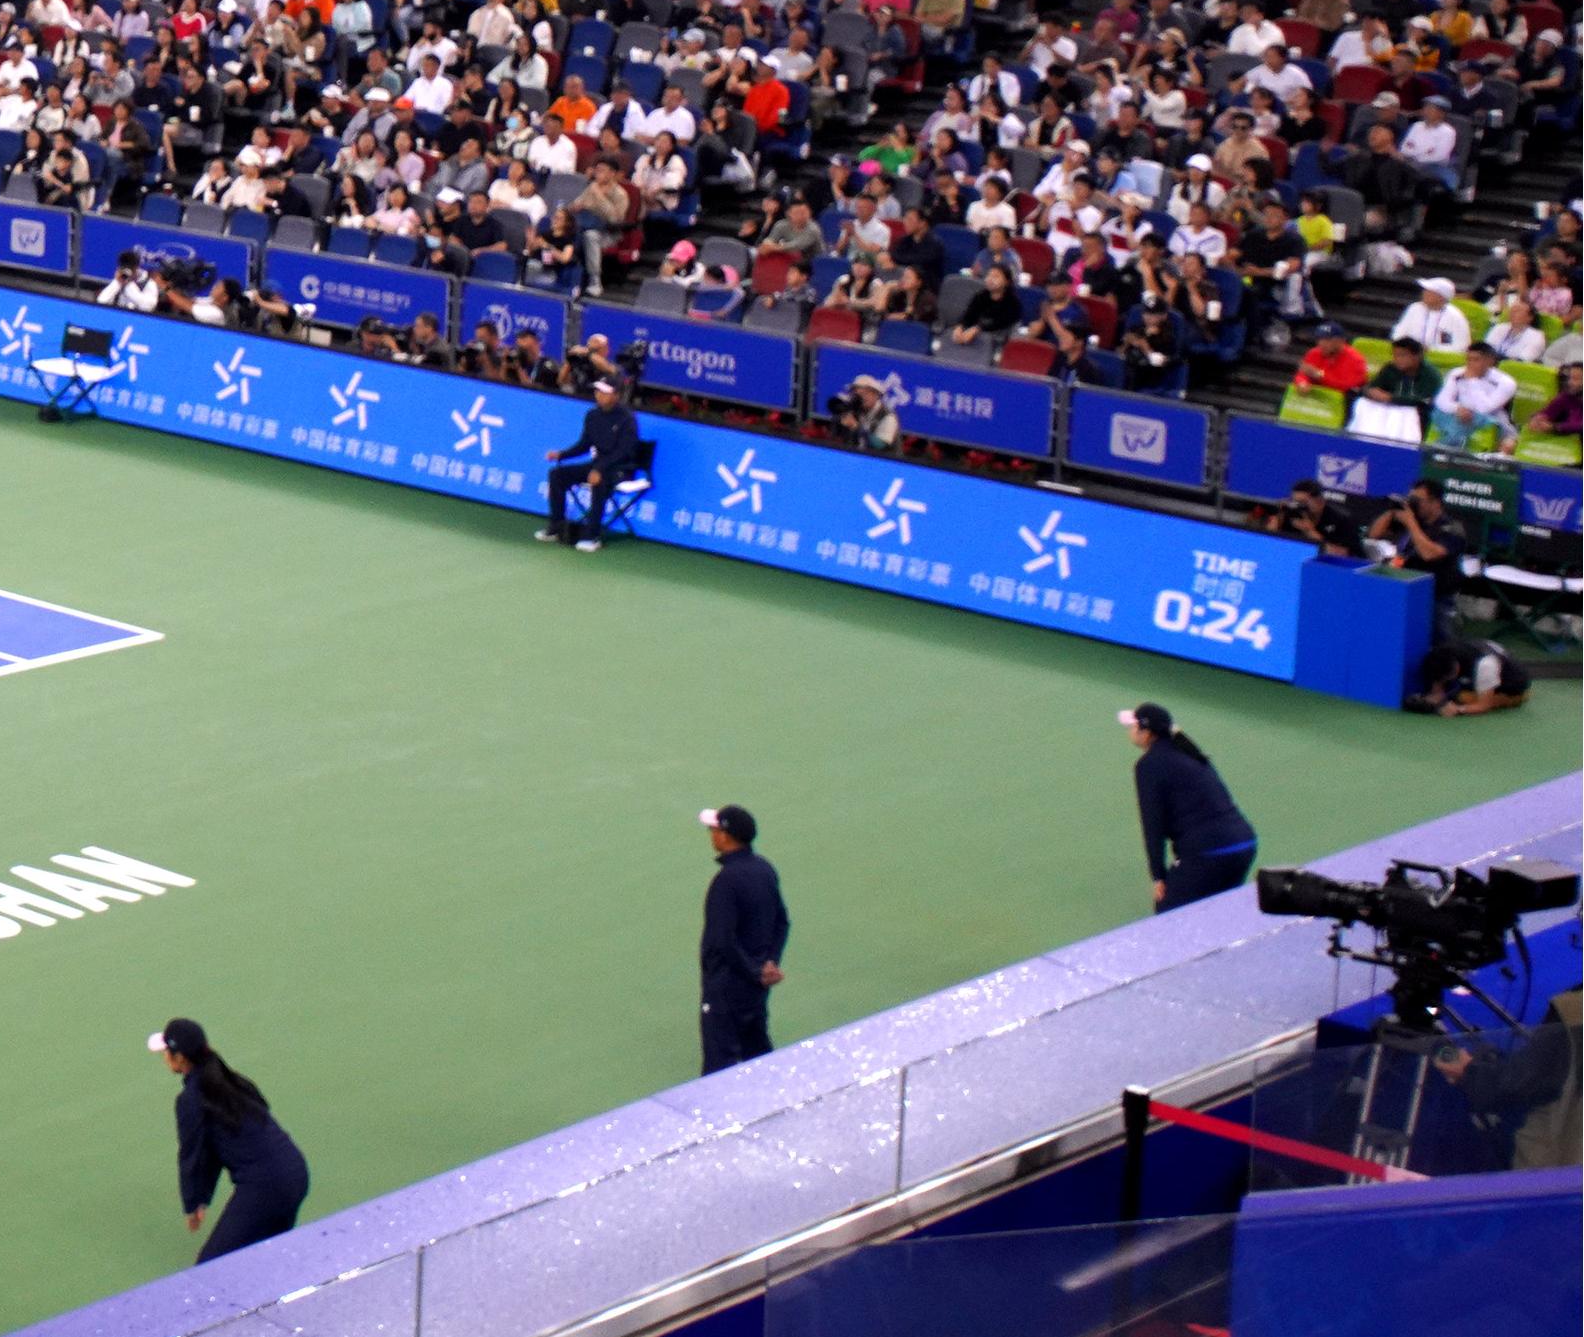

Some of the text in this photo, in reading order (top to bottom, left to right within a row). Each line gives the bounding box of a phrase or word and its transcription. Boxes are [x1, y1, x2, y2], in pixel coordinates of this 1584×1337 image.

[176, 400, 279, 440] 中国体育彩票
[291, 424, 399, 466] 中国体育彩票
[411, 452, 526, 495] 中国体育彩票
[672, 507, 801, 554] 中国体育彩票
[816, 538, 952, 587] 中国体育彩票
[1193, 549, 1258, 582] TIME
[970, 571, 1115, 623] 中国体育彩票
[1192, 573, 1247, 604] 时间
[1152, 589, 1272, 650] 0:24
